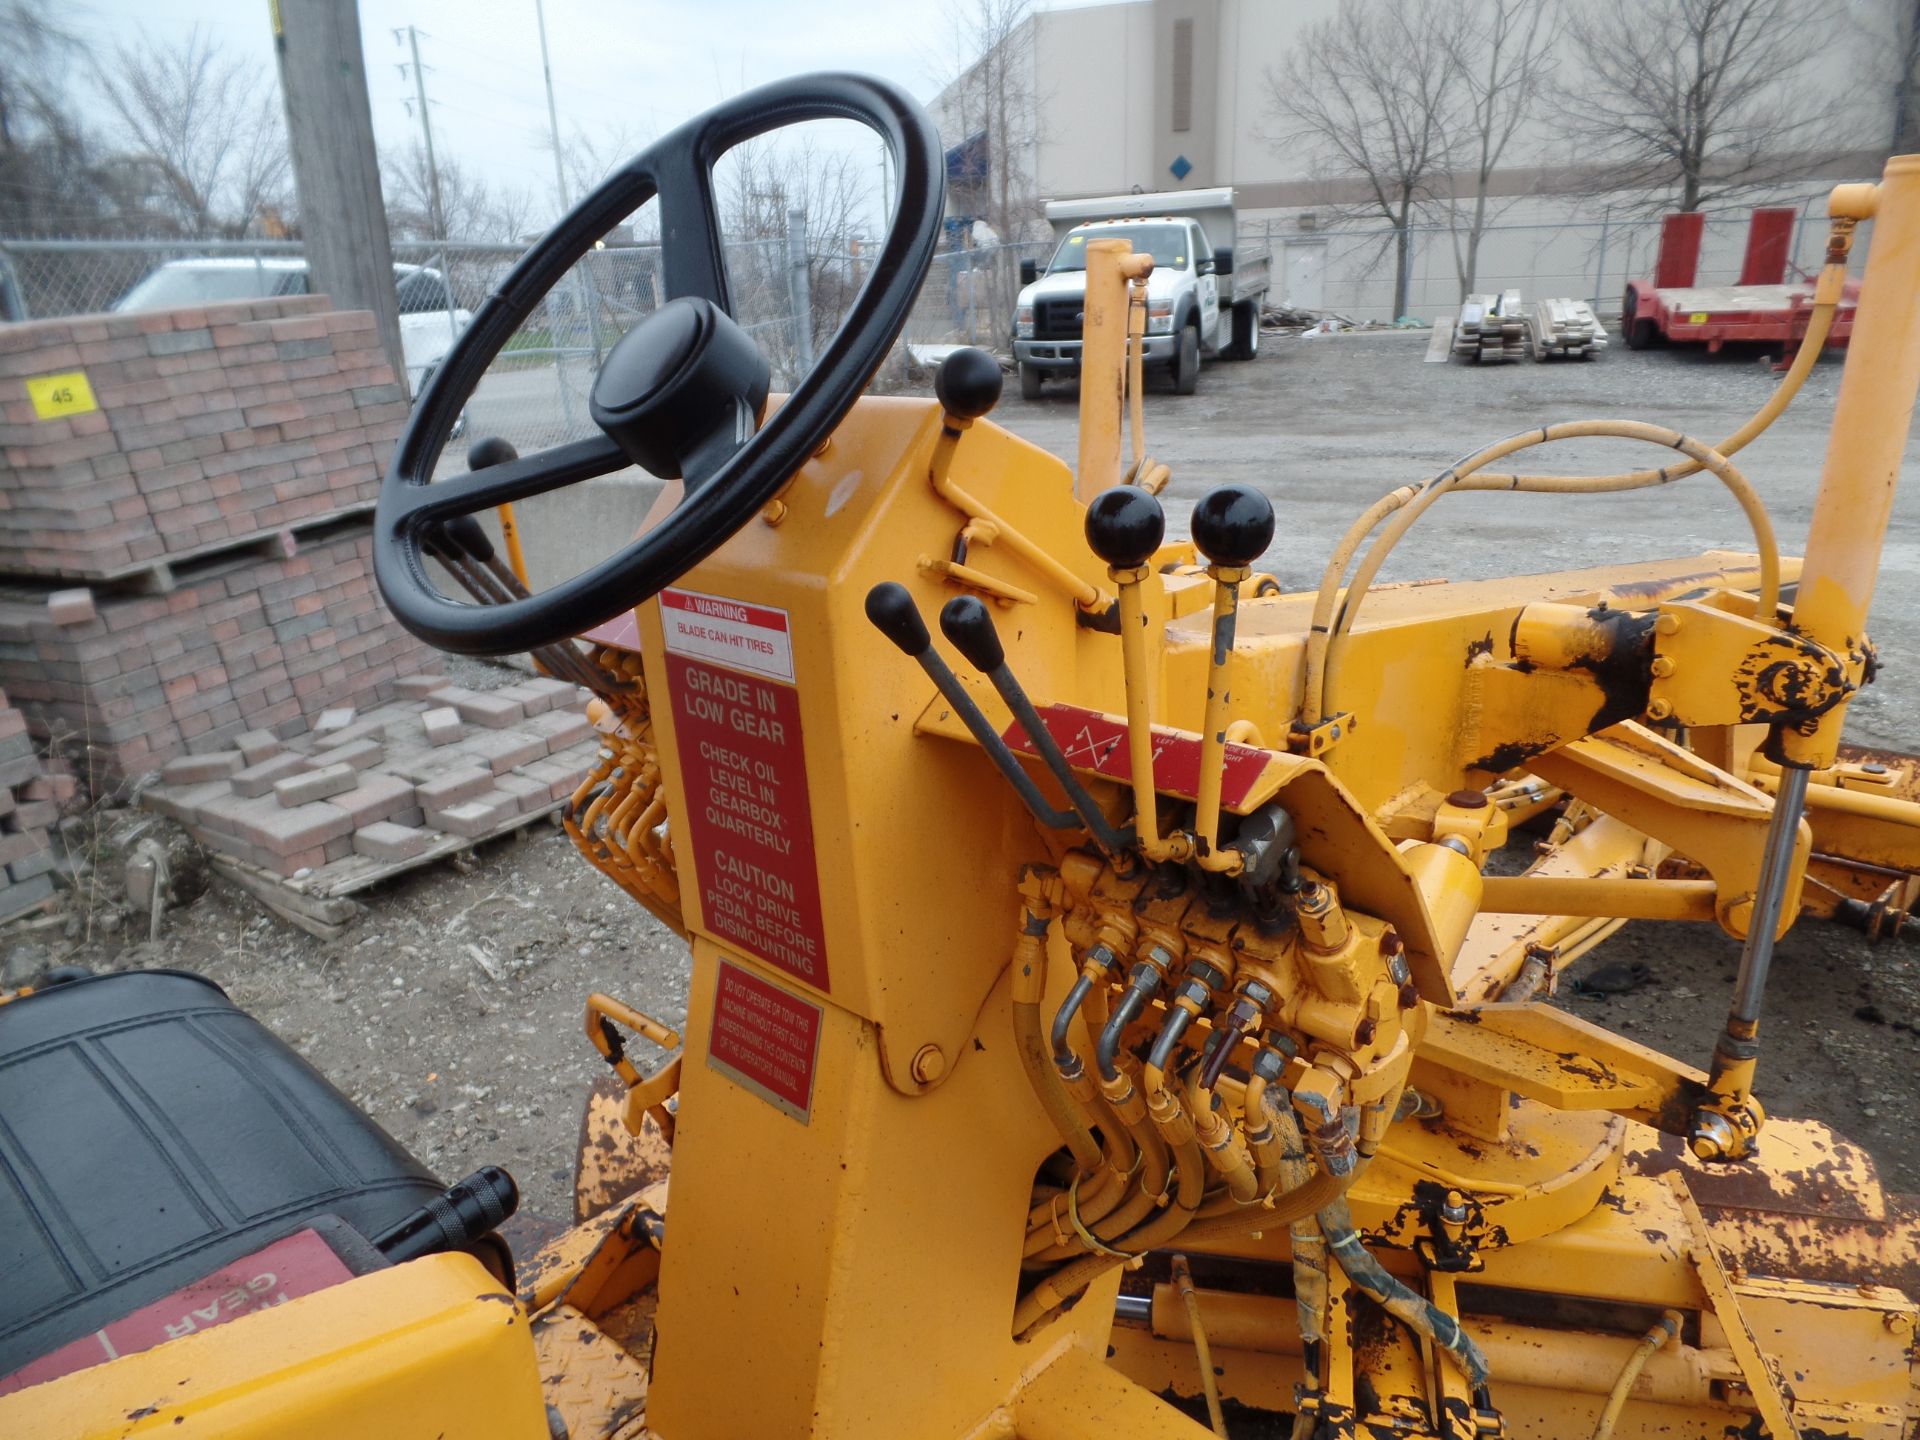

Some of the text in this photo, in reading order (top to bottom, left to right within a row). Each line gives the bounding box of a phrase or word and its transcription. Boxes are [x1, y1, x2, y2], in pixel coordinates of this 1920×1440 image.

[694, 598, 747, 622] WARNING
[677, 622, 774, 655] BLADE CAN HIT TIRES
[686, 667, 776, 714] GRADE IN
[684, 693, 785, 746] LOW GEAR
[1155, 737, 1176, 746] LEFT
[699, 740, 780, 785] CHECK OIL
[1224, 753, 1244, 762] IGHT
[1240, 750, 1259, 758] LIFT
[709, 766, 775, 805] LEVEL IN
[709, 787, 783, 831] GEARBOX
[705, 807, 791, 855] QUARTERLY
[714, 850, 794, 903] CAUTION
[707, 890, 817, 956] PEDAL BEFORE
[715, 873, 801, 928] LOCK DRIVE
[714, 912, 814, 976] DISMOUNTING
[722, 996, 807, 1052] MACHINE WITHOUT FIRST FULLY
[725, 977, 809, 1033] DO NOT OPERATE OR TOW THIS
[718, 1014, 806, 1075] UNDERSTANDING THE CONTENTS
[720, 1035, 728, 1048] OF
[728, 1039, 739, 1057] THE
[163, 1272, 278, 1339] GEAR
